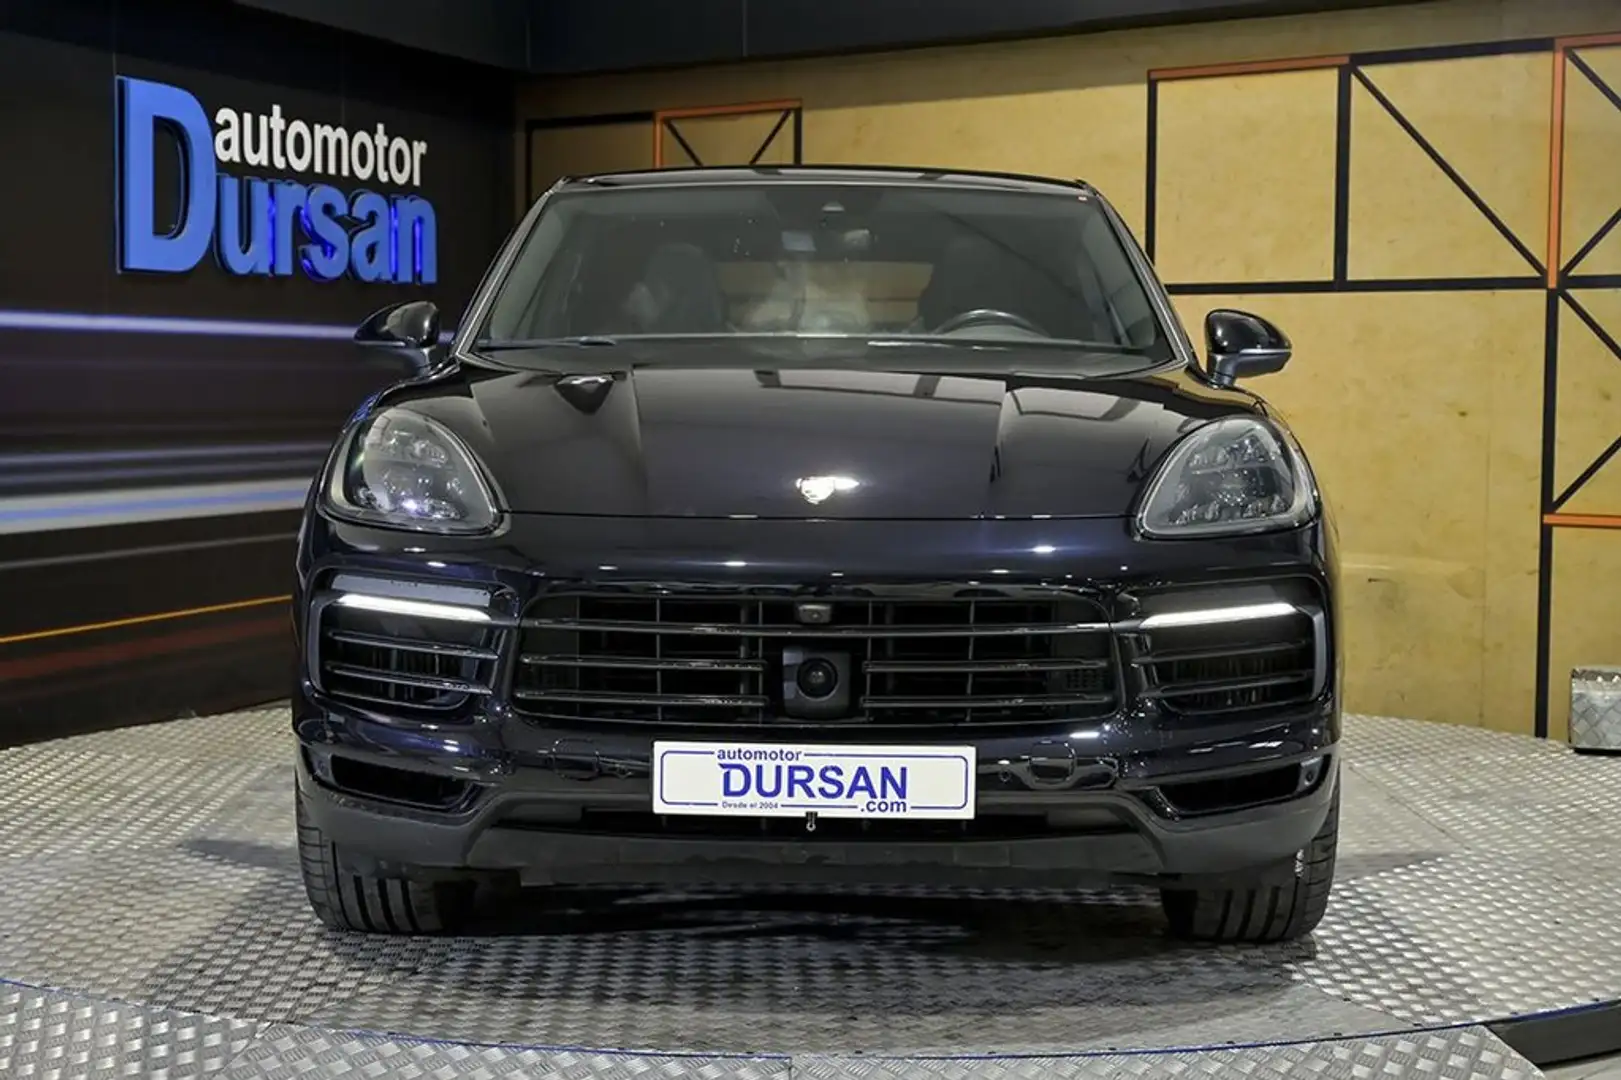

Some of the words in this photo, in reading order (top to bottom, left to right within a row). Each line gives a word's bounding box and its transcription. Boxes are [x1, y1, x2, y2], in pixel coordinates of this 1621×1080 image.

[214, 104, 428, 187] automotor
[115, 75, 438, 285] Dursan
[717, 748, 803, 761] automotor
[718, 763, 907, 799] DURSAN
[722, 801, 747, 809] Desde
[860, 800, 907, 813] .com
